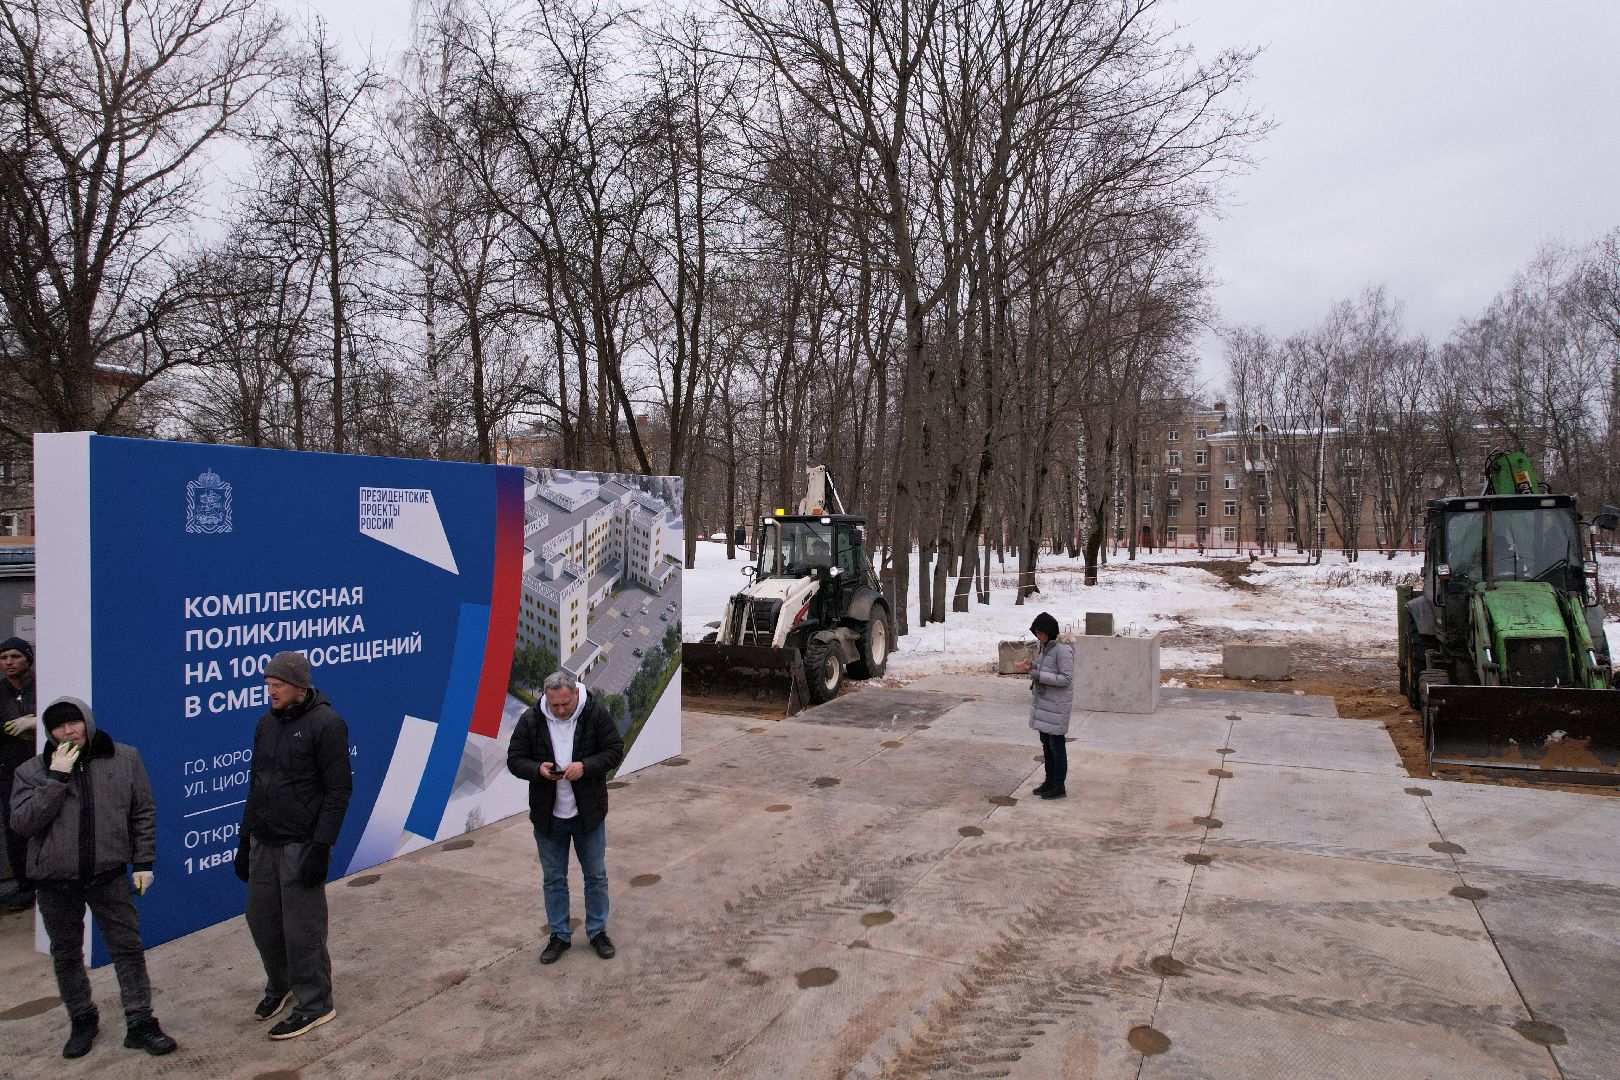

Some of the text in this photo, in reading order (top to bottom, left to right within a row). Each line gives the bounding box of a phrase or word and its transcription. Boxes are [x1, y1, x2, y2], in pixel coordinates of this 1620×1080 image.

[361, 489, 430, 504] ПРЕЗИДЕНТСКИЕ
[361, 503, 401, 517] ПРОЕКТЫ
[361, 517, 394, 531] РОССИИ
[185, 585, 364, 619] КОМПЛЕКСНАЯ
[185, 613, 366, 652] ПОЛИКЛИНИКА
[185, 661, 223, 686] НА
[229, 651, 279, 678] 100
[185, 695, 202, 718] В
[184, 758, 209, 776] Г.О.
[213, 748, 253, 769] КОРО
[184, 780, 208, 798] УЛ.
[184, 857, 193, 875] 1
